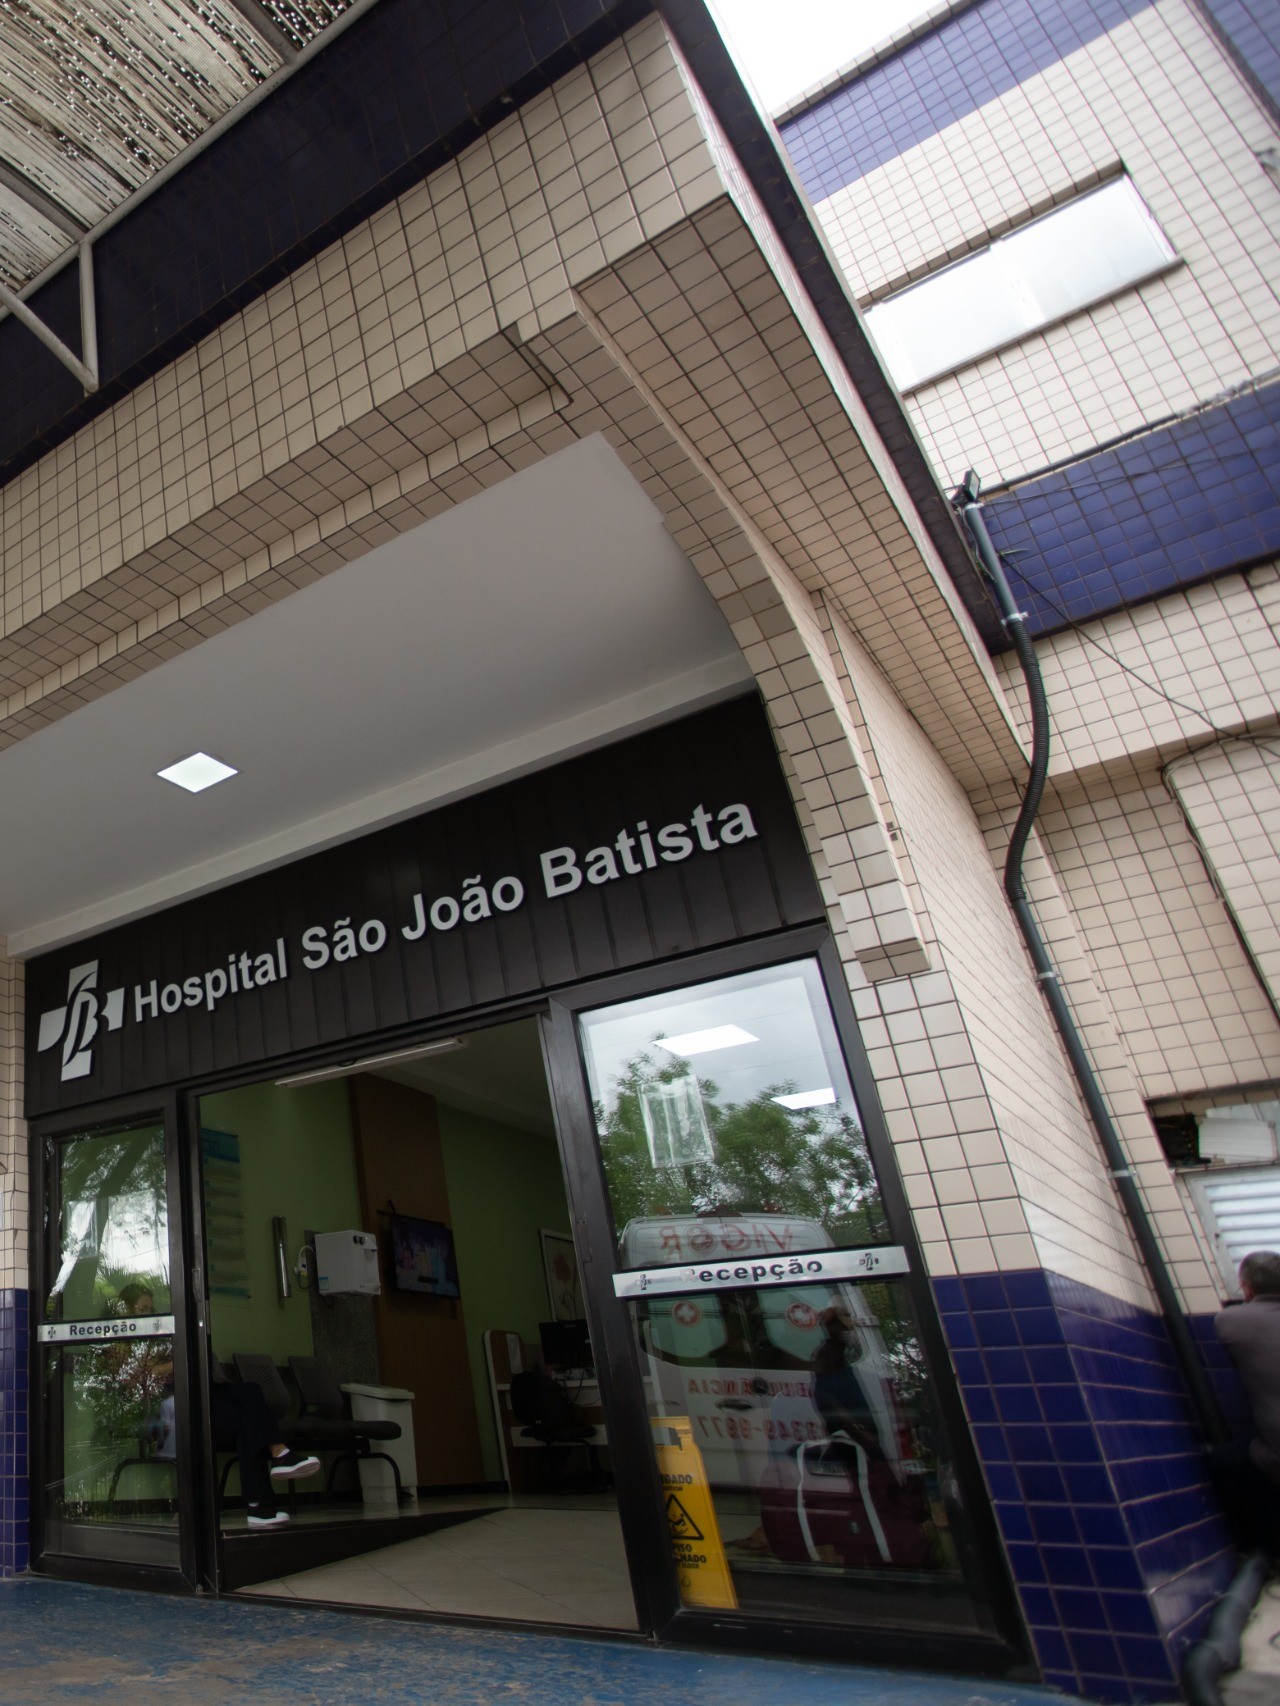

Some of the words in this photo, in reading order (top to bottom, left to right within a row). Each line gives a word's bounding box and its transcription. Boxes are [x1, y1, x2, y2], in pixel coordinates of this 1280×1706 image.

[134, 938, 289, 1023] Hospital
[302, 915, 387, 970] São
[401, 874, 525, 941] João
[540, 801, 759, 899] Batista
[680, 1258, 823, 1283] Recepção
[69, 1321, 137, 1338] Recepção
